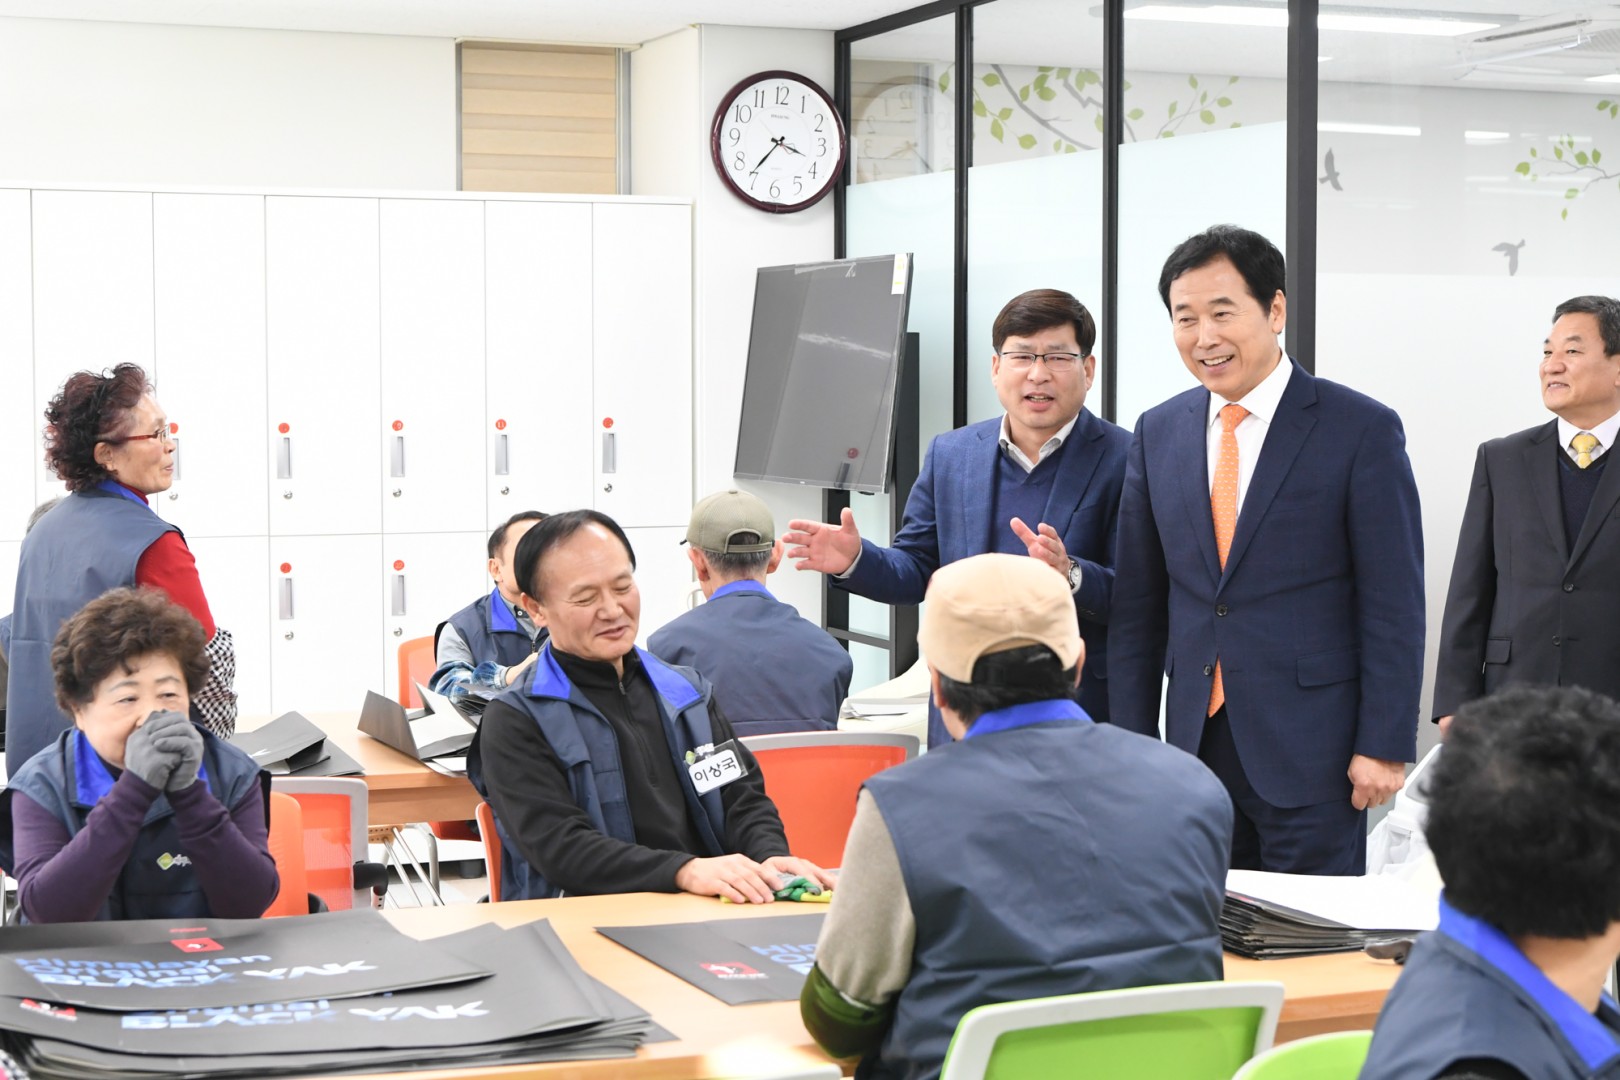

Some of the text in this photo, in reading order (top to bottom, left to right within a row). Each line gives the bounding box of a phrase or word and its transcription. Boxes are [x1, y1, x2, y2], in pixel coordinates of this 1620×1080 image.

[754, 89, 765, 108] 11
[775, 86, 790, 105] 12
[800, 95, 806, 113] 1
[735, 104, 752, 123] 10
[814, 113, 824, 132] 2
[729, 127, 741, 147] 9
[816, 137, 826, 157] 3
[734, 151, 745, 171] 8
[808, 161, 818, 179] 4
[749, 170, 759, 190] 7
[769, 179, 780, 198] 6
[793, 176, 803, 196] 5
[694, 757, 737, 782] 이상국
[15, 954, 272, 970] Himalayan
[23, 964, 222, 979] Original
[33, 960, 379, 988] BLACK YAK
[121, 1000, 491, 1029] BLACK YAK
